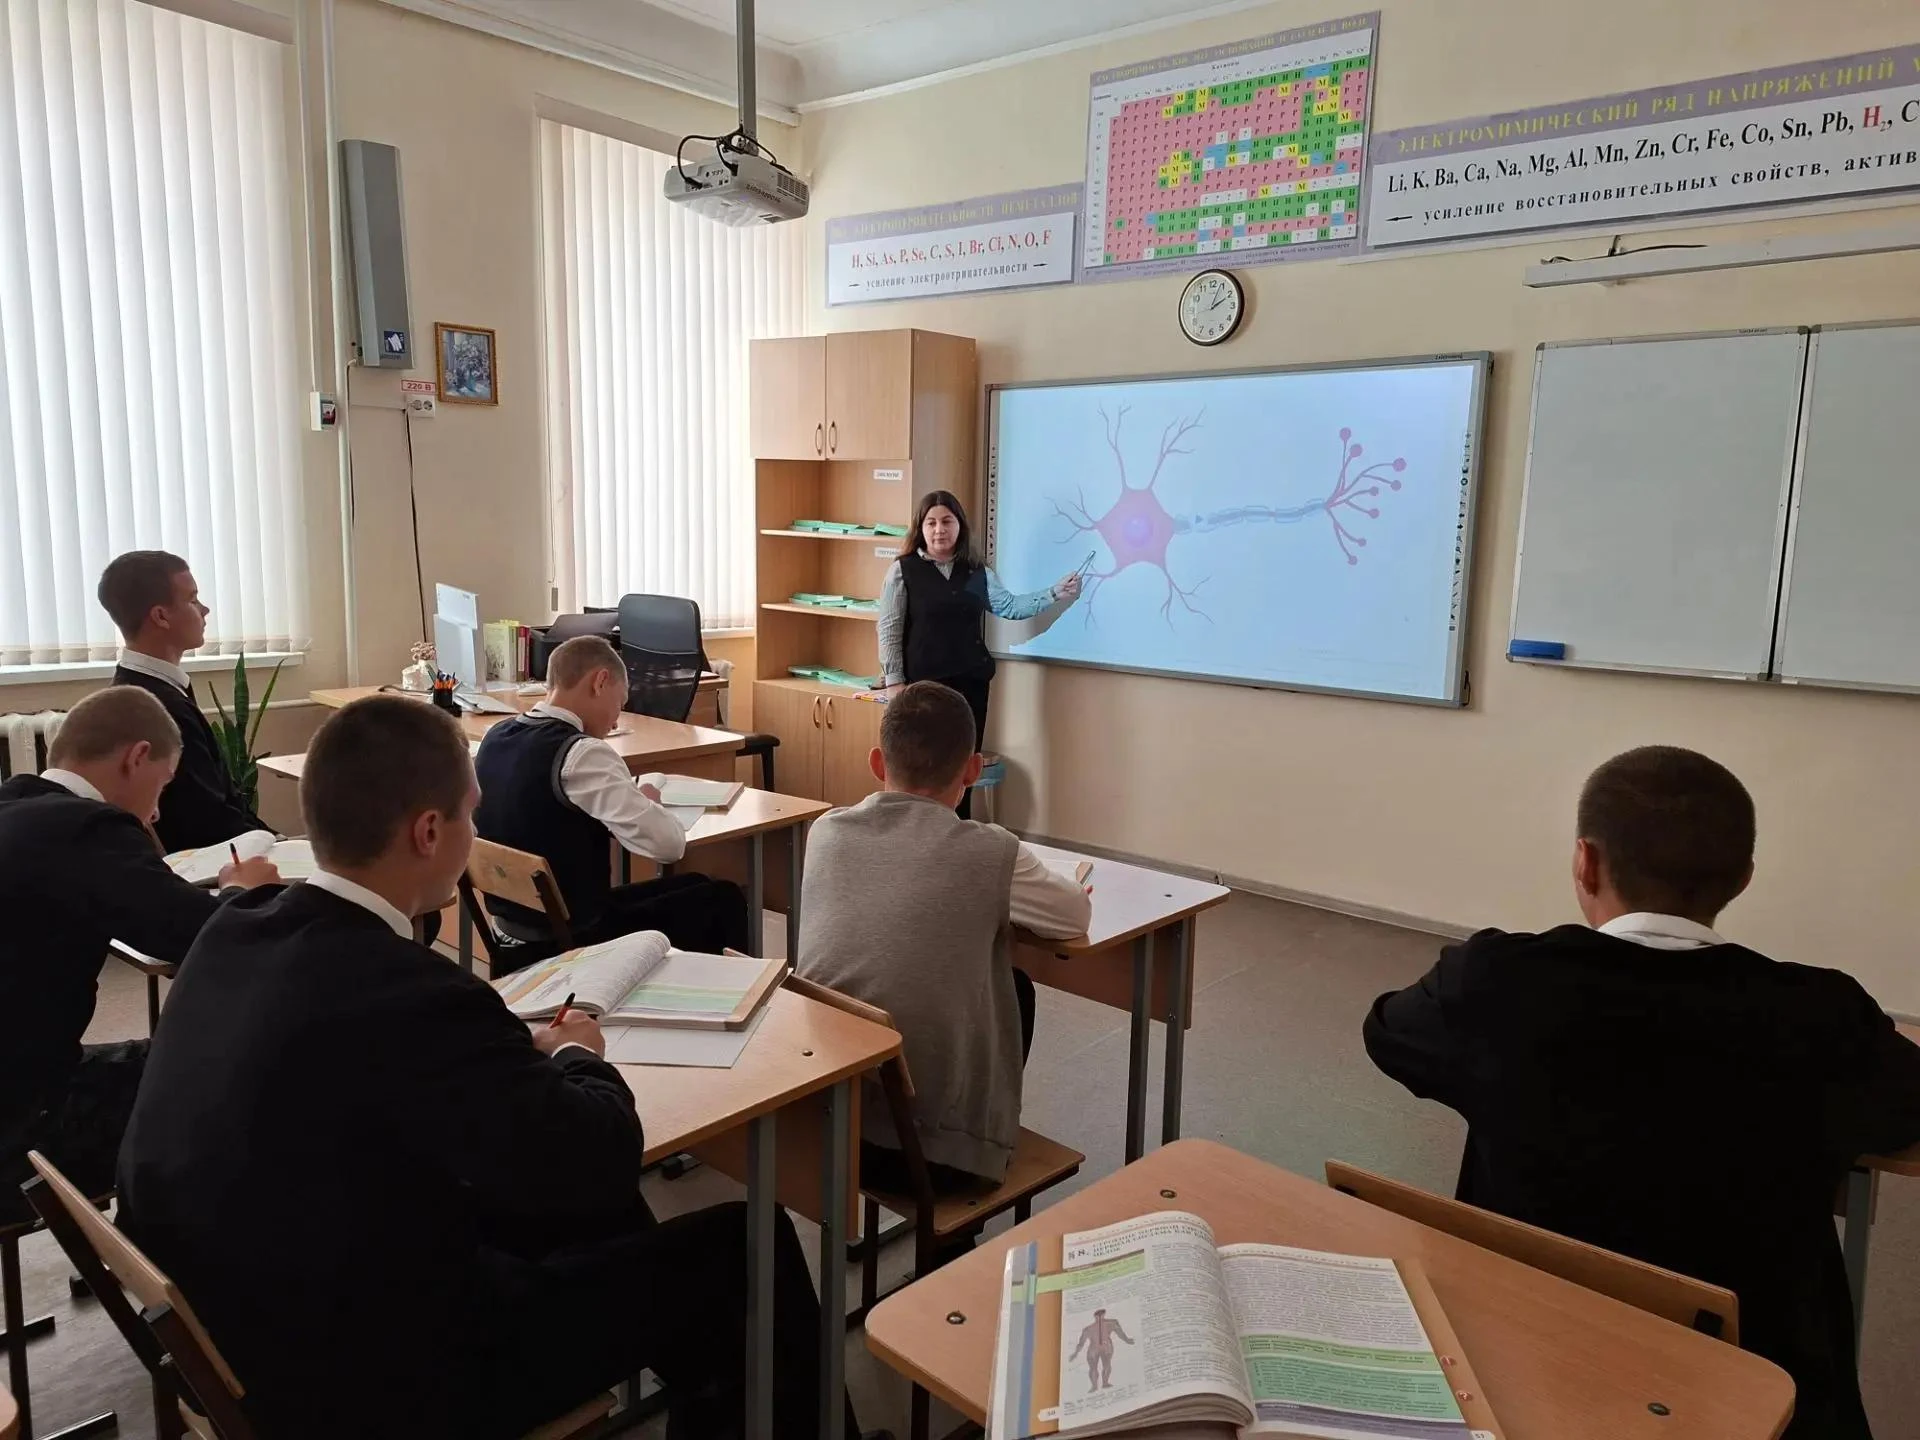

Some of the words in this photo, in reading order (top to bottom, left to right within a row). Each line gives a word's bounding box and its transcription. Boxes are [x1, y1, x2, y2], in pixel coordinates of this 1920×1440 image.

[1707, 57, 1896, 106] НАПРЯЖЕНИЙ
[1387, 174, 1408, 193] Li,
[1413, 171, 1429, 190] K,
[1434, 168, 1459, 187] Ba,
[1464, 163, 1490, 184] Ca,
[1496, 159, 1522, 178] Na,
[1527, 153, 1560, 176] Mg,
[1563, 148, 1588, 170] Al,
[1594, 143, 1629, 166] Mn,
[1634, 138, 1665, 160] Zn,
[1671, 133, 1700, 154] Cr,
[1706, 128, 1735, 150] Fe,
[1741, 122, 1774, 146] Co,
[1781, 117, 1813, 139] Sn,
[1820, 111, 1854, 135] Pb,
[1424, 200, 1505, 225] усиление
[1515, 175, 1718, 211] восстановительных
[1731, 163, 1830, 185] свойств,
[1209, 280, 1217, 288] 12
